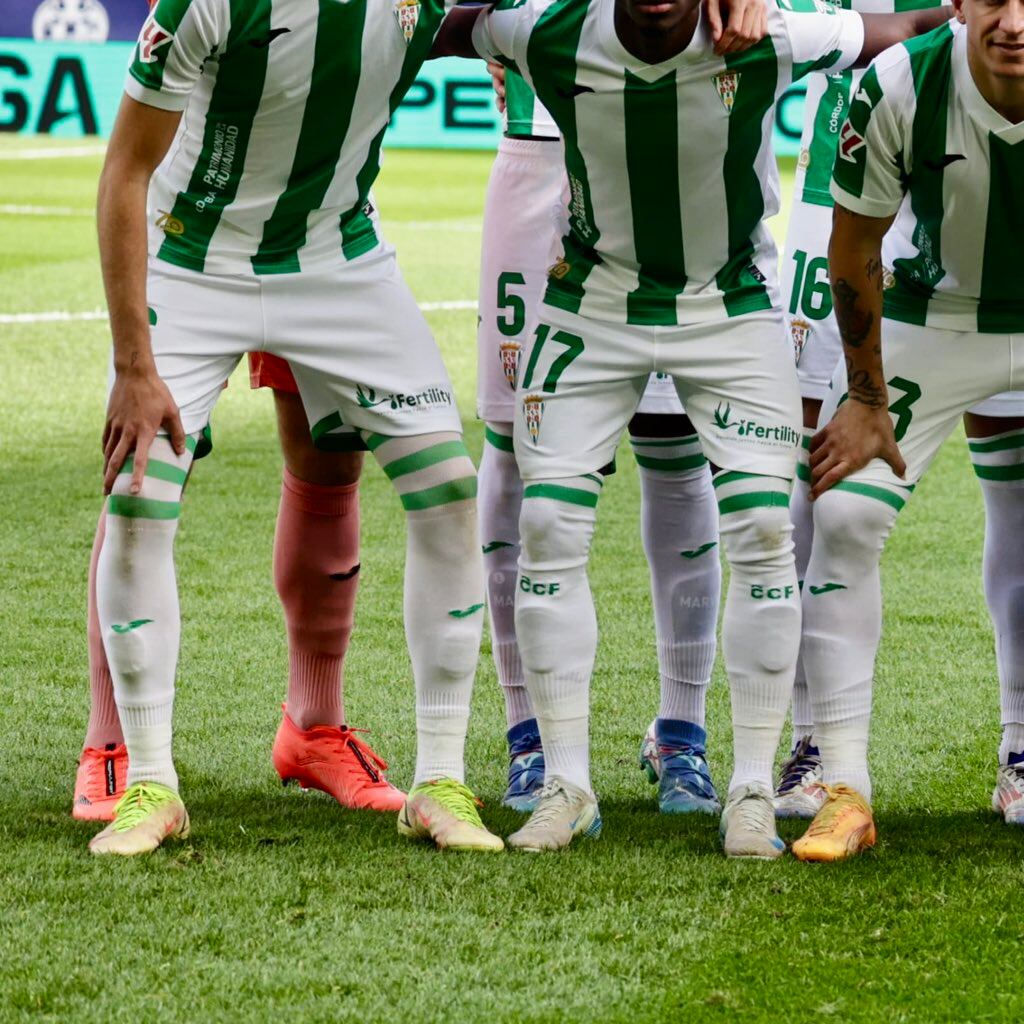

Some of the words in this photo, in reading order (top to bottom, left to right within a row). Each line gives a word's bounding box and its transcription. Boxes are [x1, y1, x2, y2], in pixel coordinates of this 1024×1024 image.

[497, 272, 526, 336] 5
[789, 249, 833, 320] 16
[522, 324, 585, 393] 17
